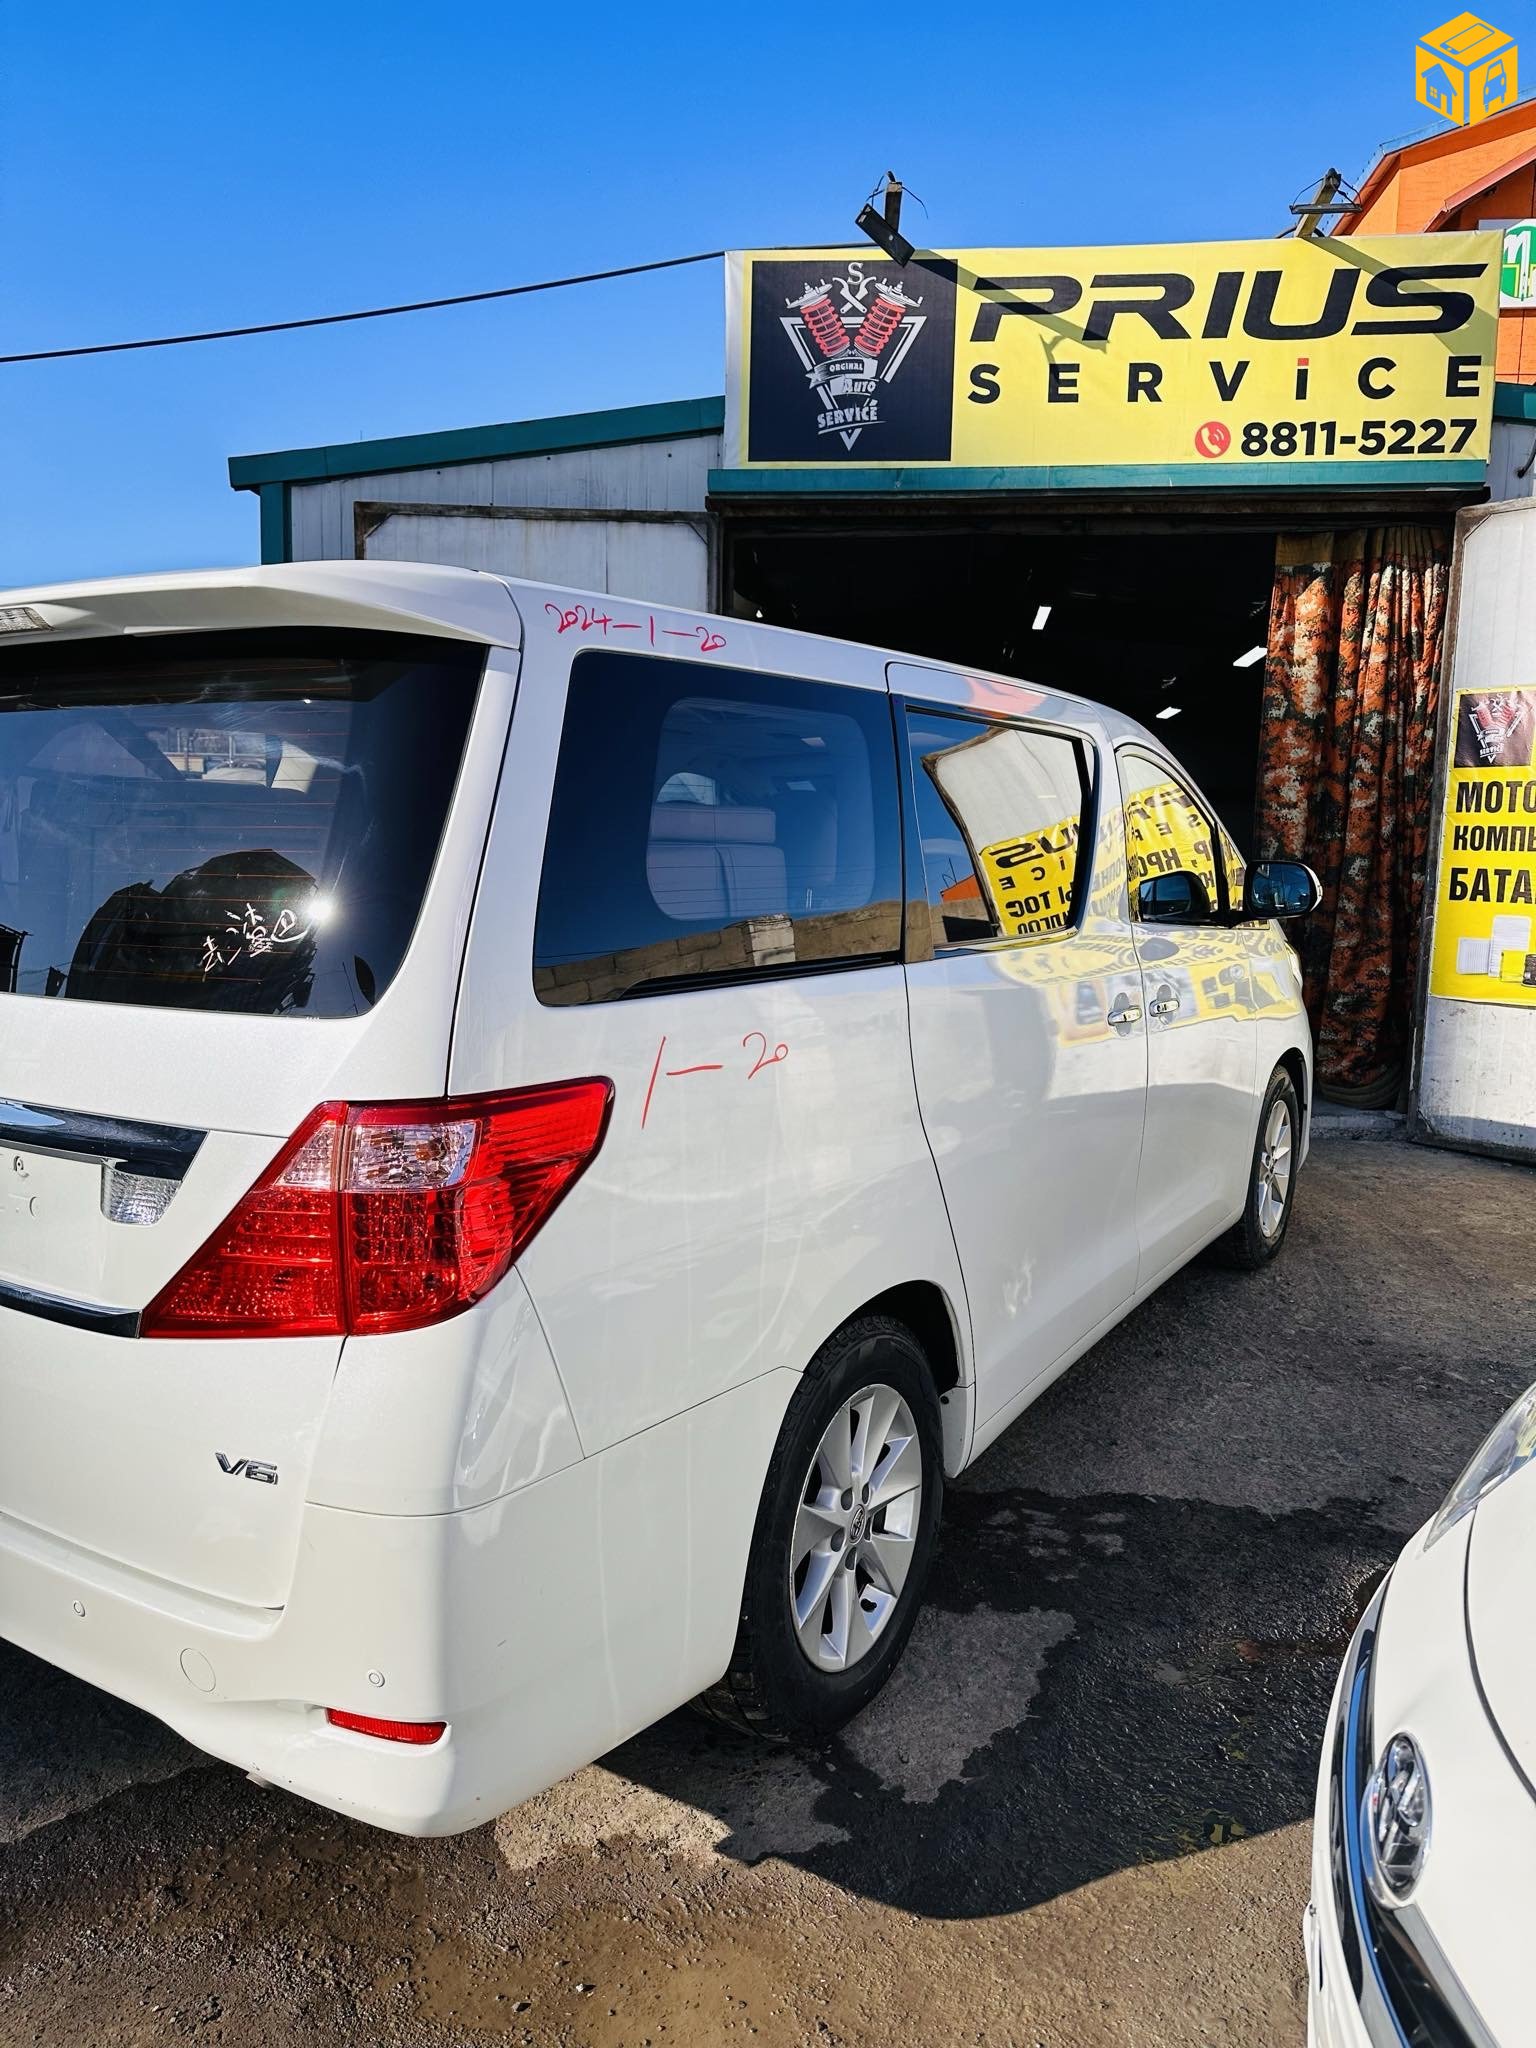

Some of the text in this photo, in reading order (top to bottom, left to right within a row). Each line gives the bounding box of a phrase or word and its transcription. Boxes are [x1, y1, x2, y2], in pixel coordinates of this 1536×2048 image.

[970, 264, 1488, 341] PRIUS
[1241, 419, 1477, 456] 8811-5227
[1449, 867, 1536, 904] БАТА
[215, 1452, 279, 1485] V6
